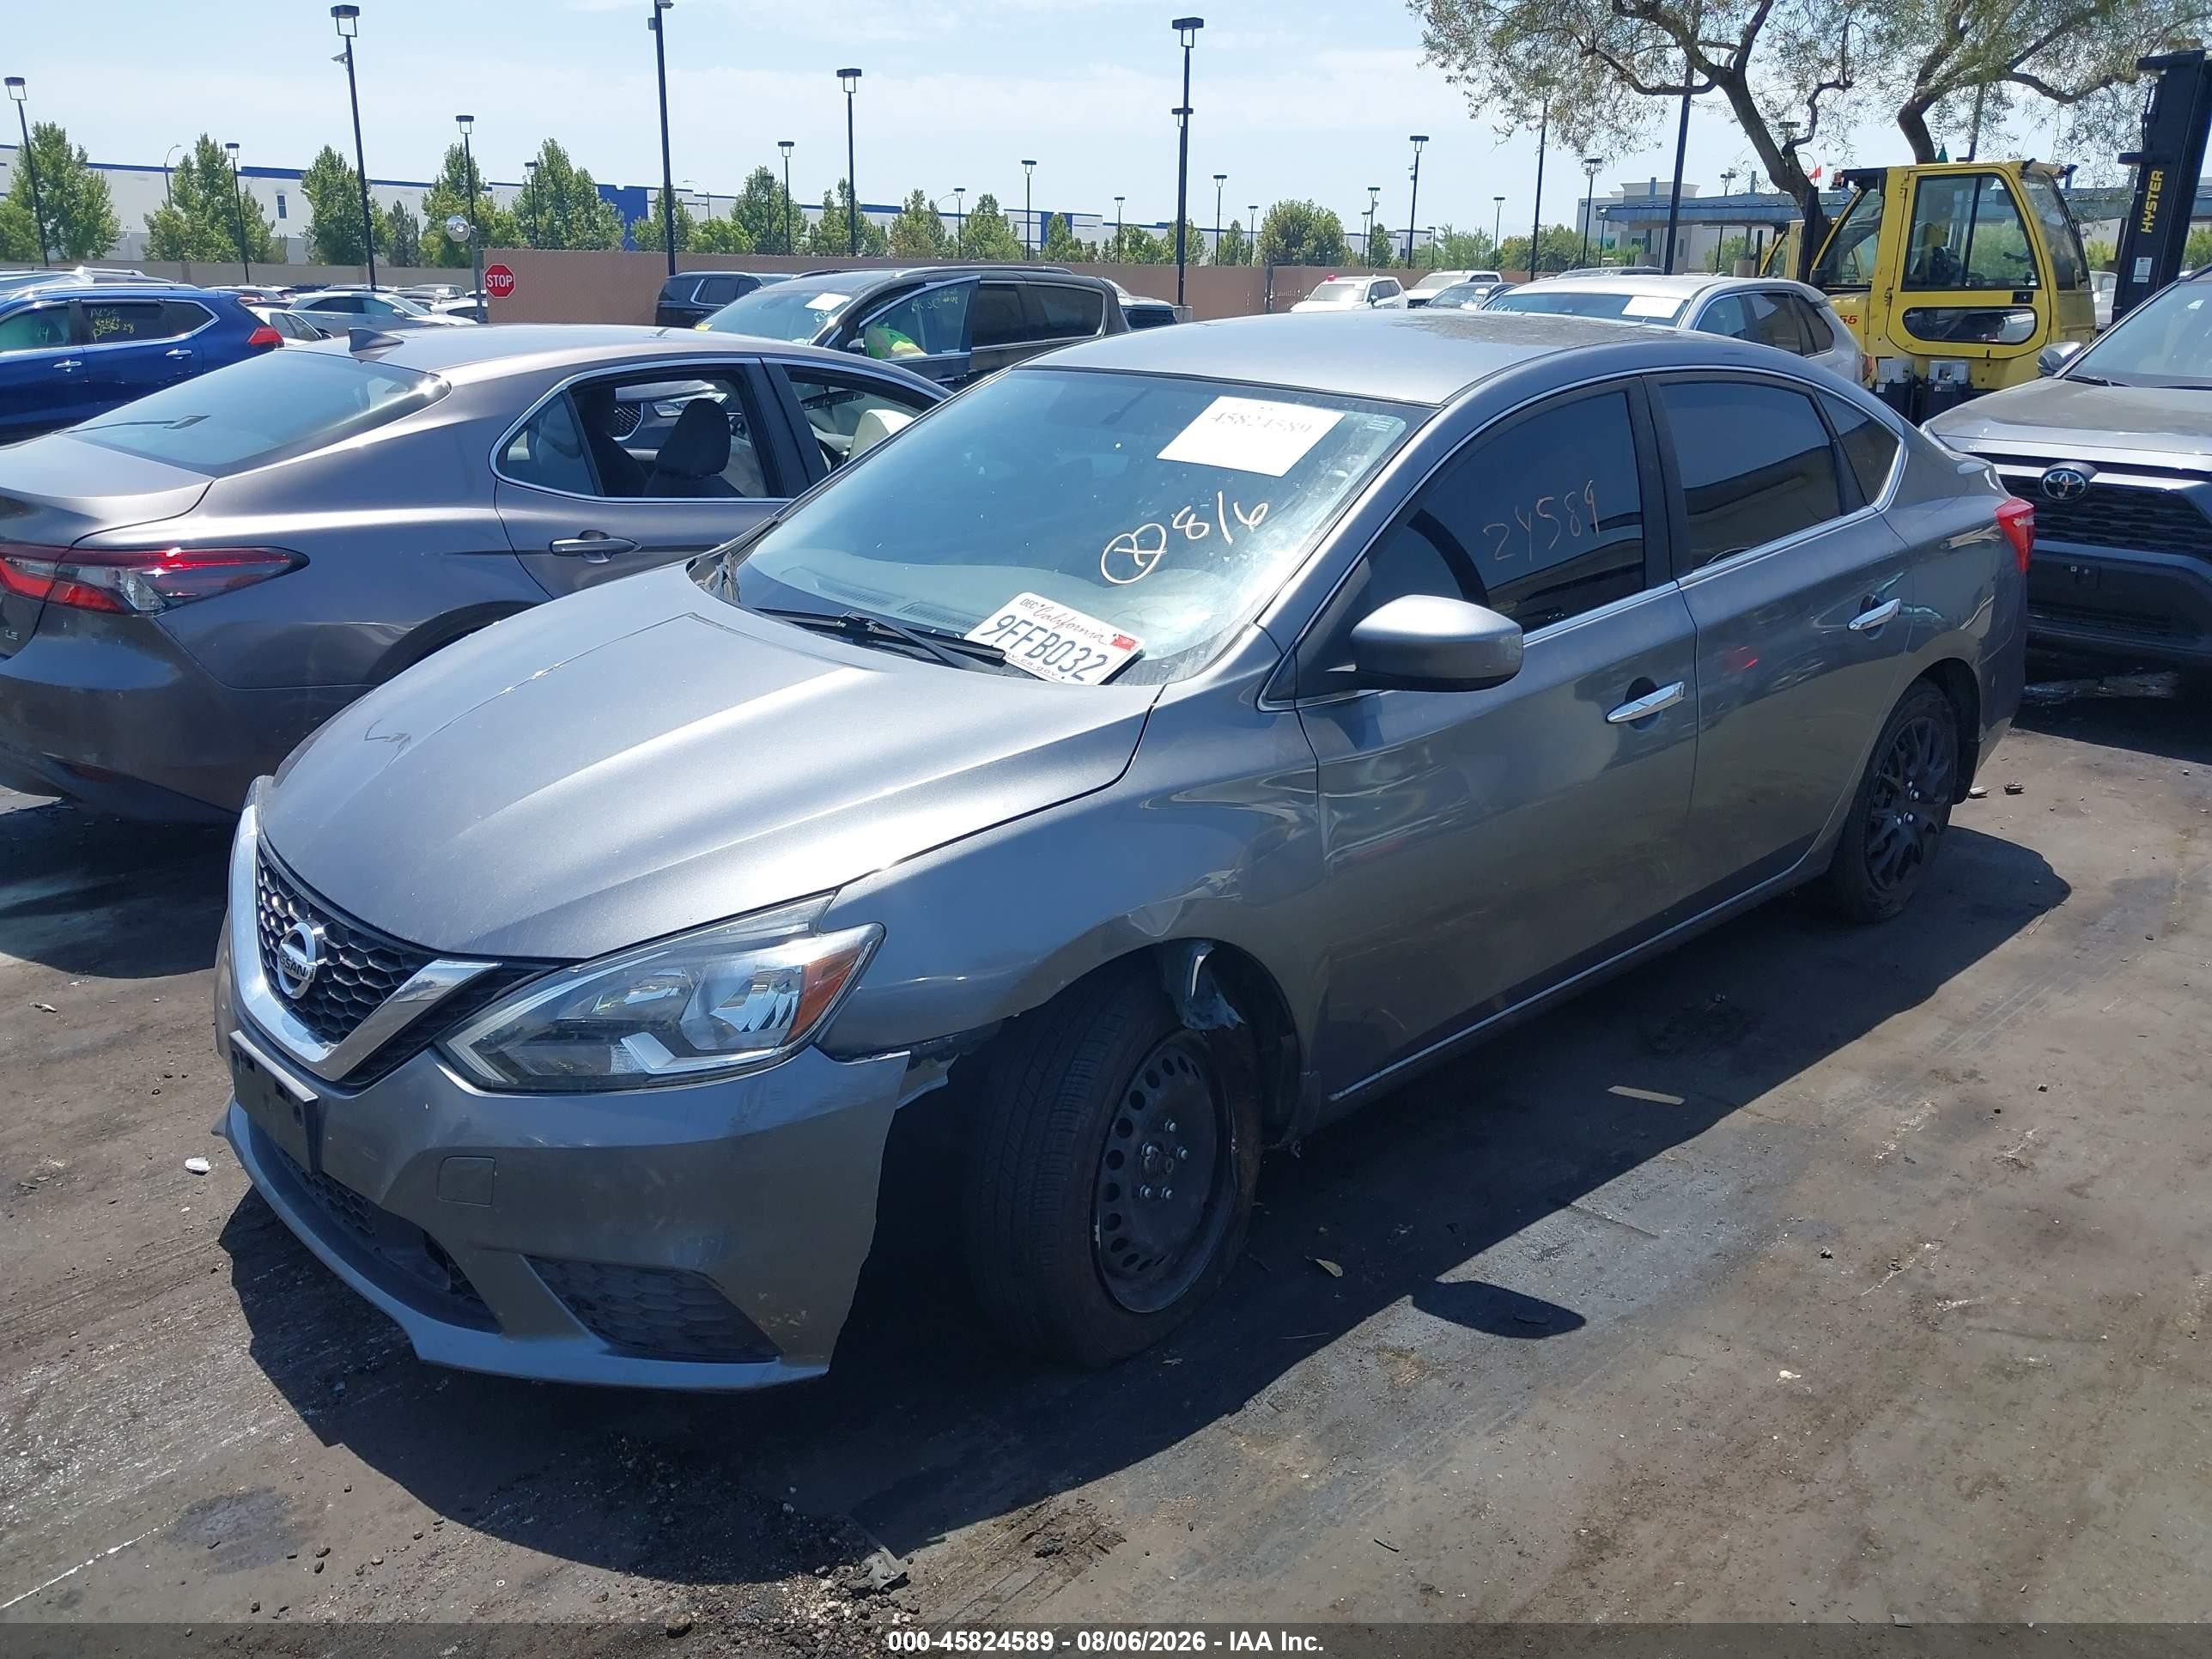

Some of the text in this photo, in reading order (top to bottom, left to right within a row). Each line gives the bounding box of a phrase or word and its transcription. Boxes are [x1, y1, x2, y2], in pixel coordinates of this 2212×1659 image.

[2141, 170, 2164, 234] HYSTER
[487, 274, 514, 288] STOP
[1019, 598, 1038, 611] DEC
[1033, 604, 1109, 646] California
[980, 614, 1109, 682] 9FFB032
